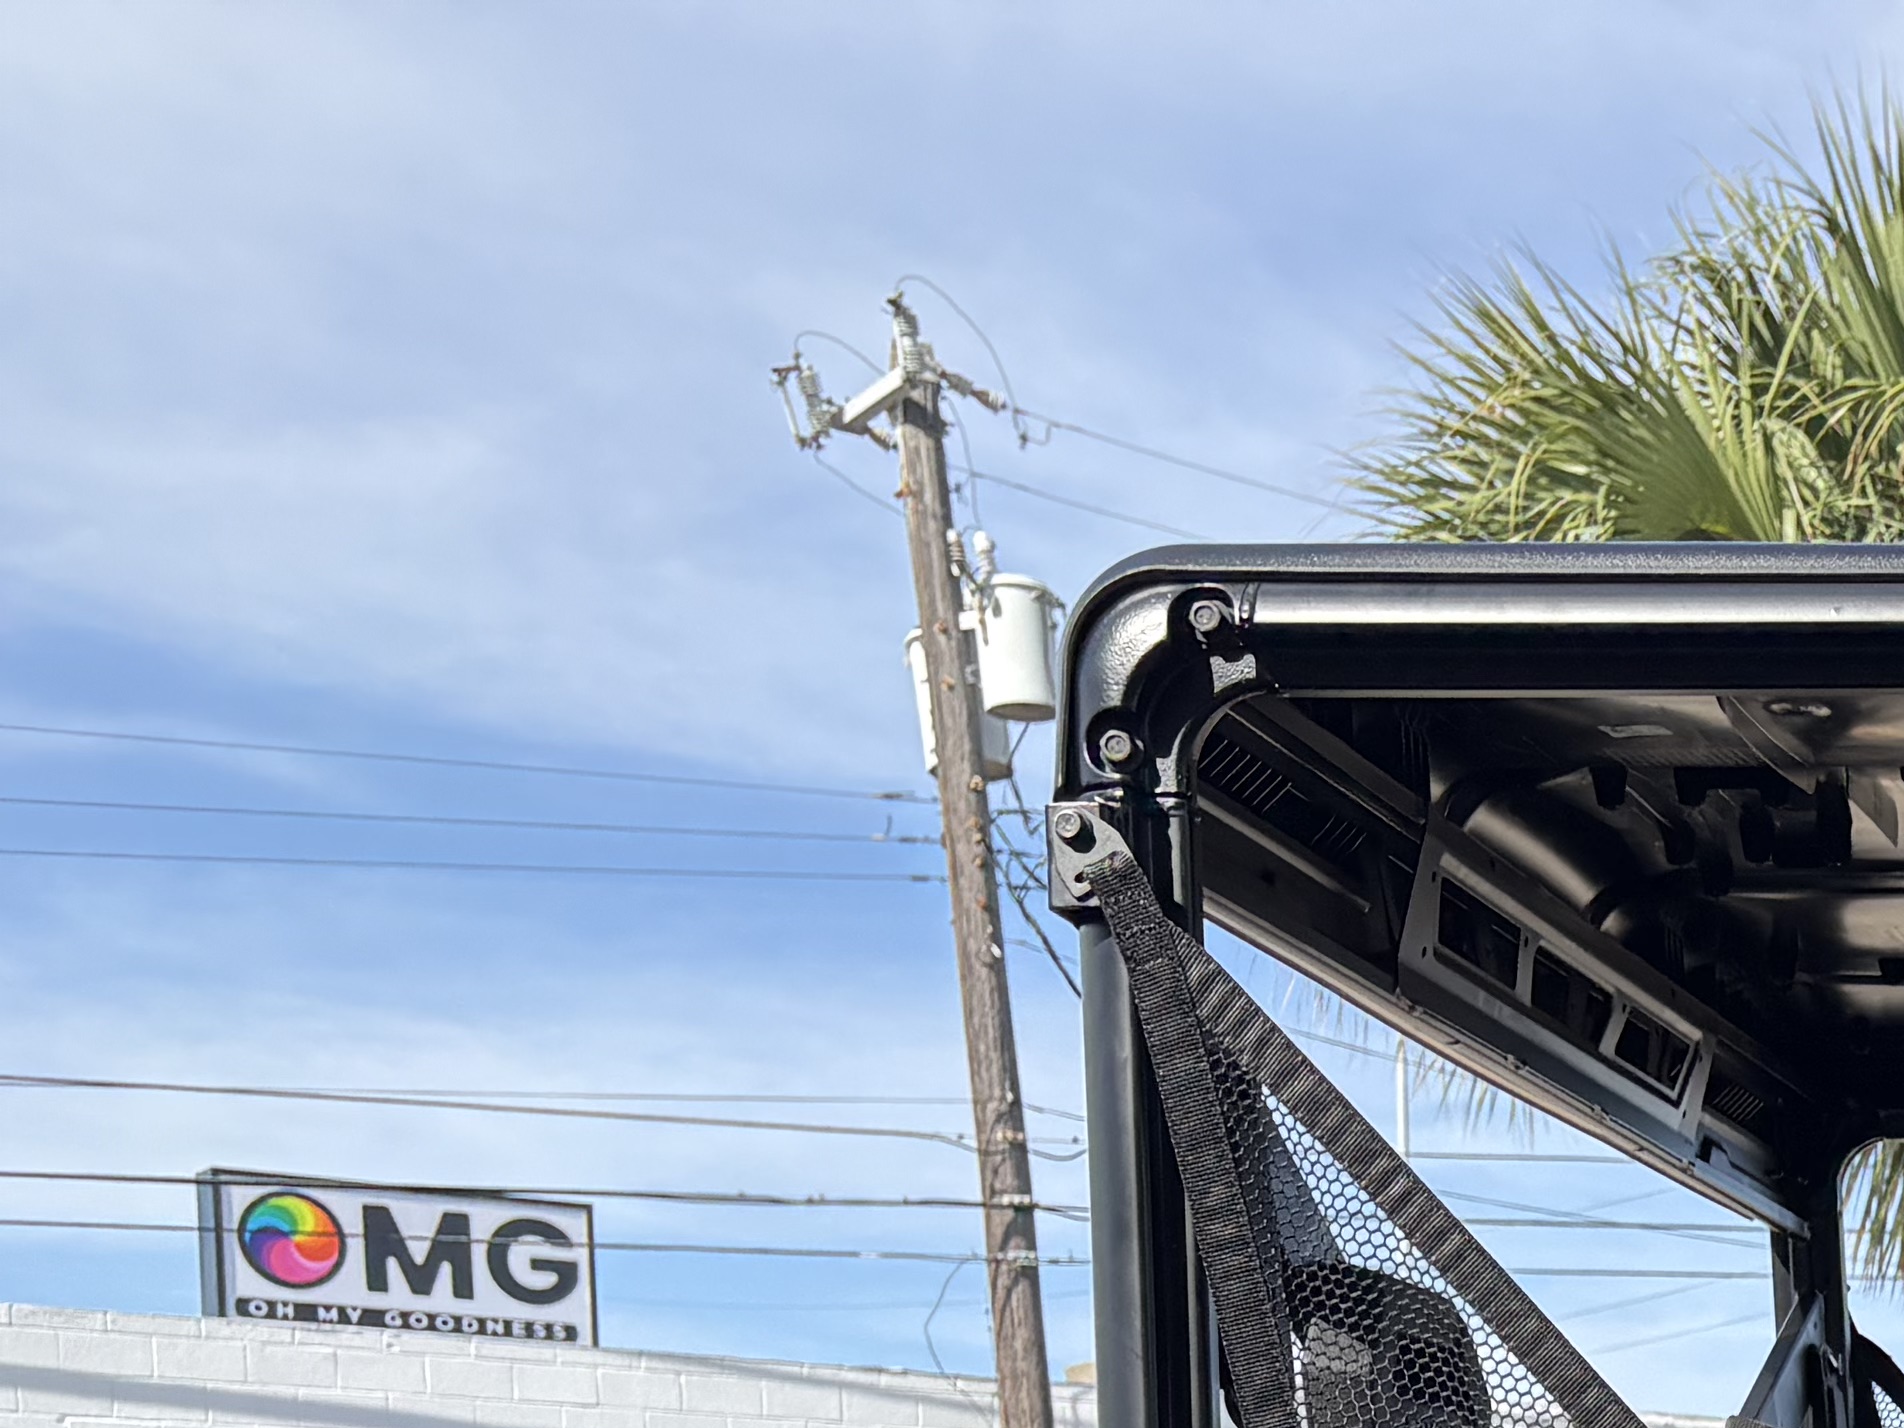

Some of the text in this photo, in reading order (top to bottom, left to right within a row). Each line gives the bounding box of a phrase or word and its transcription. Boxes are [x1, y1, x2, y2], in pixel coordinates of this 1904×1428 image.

[247, 1299, 567, 1342] OH MY GOODNESS
